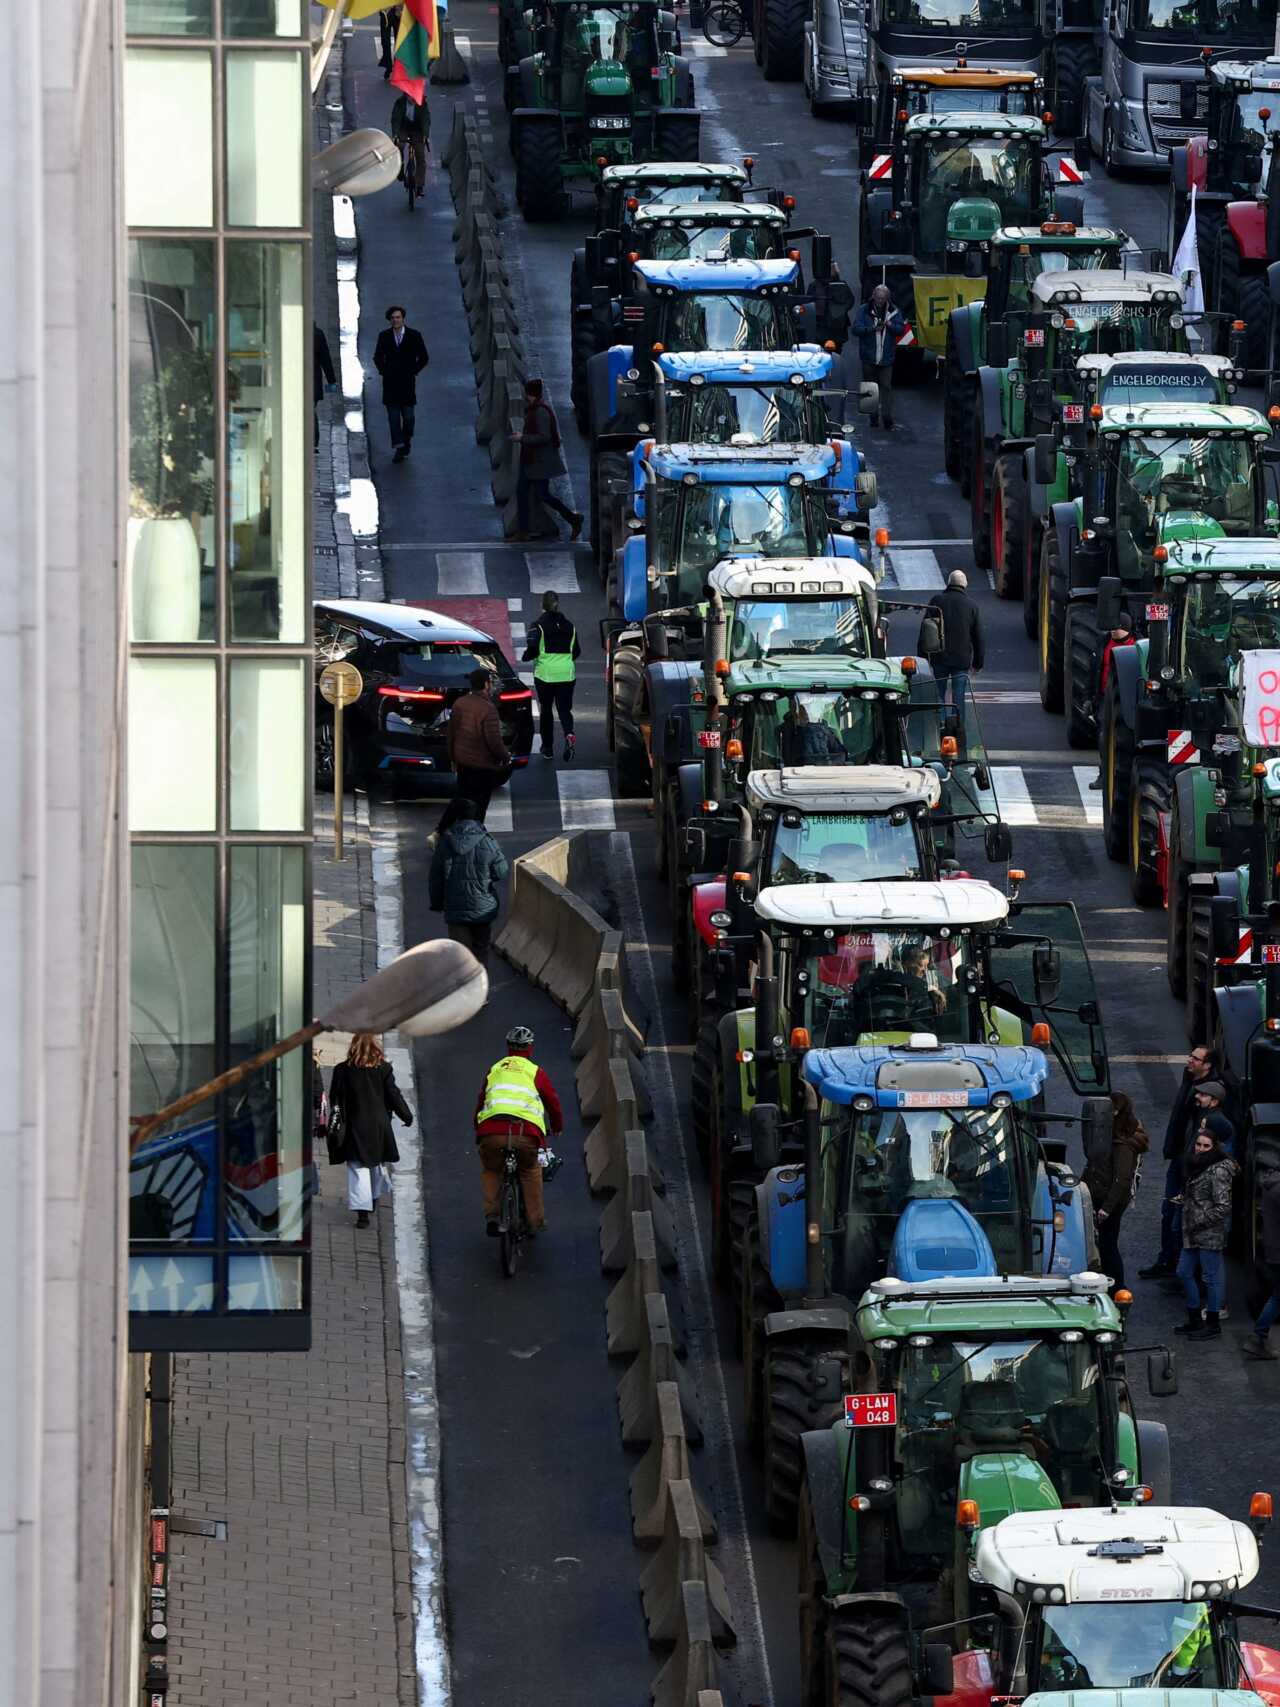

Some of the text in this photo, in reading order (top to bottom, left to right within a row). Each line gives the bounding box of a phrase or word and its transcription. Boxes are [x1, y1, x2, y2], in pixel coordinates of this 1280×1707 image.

[1113, 375, 1191, 386] ENGELBORGHS
[851, 1396, 889, 1409] G-LAW
[866, 1411, 890, 1423] 048
[1100, 1588, 1154, 1598] STEYR
